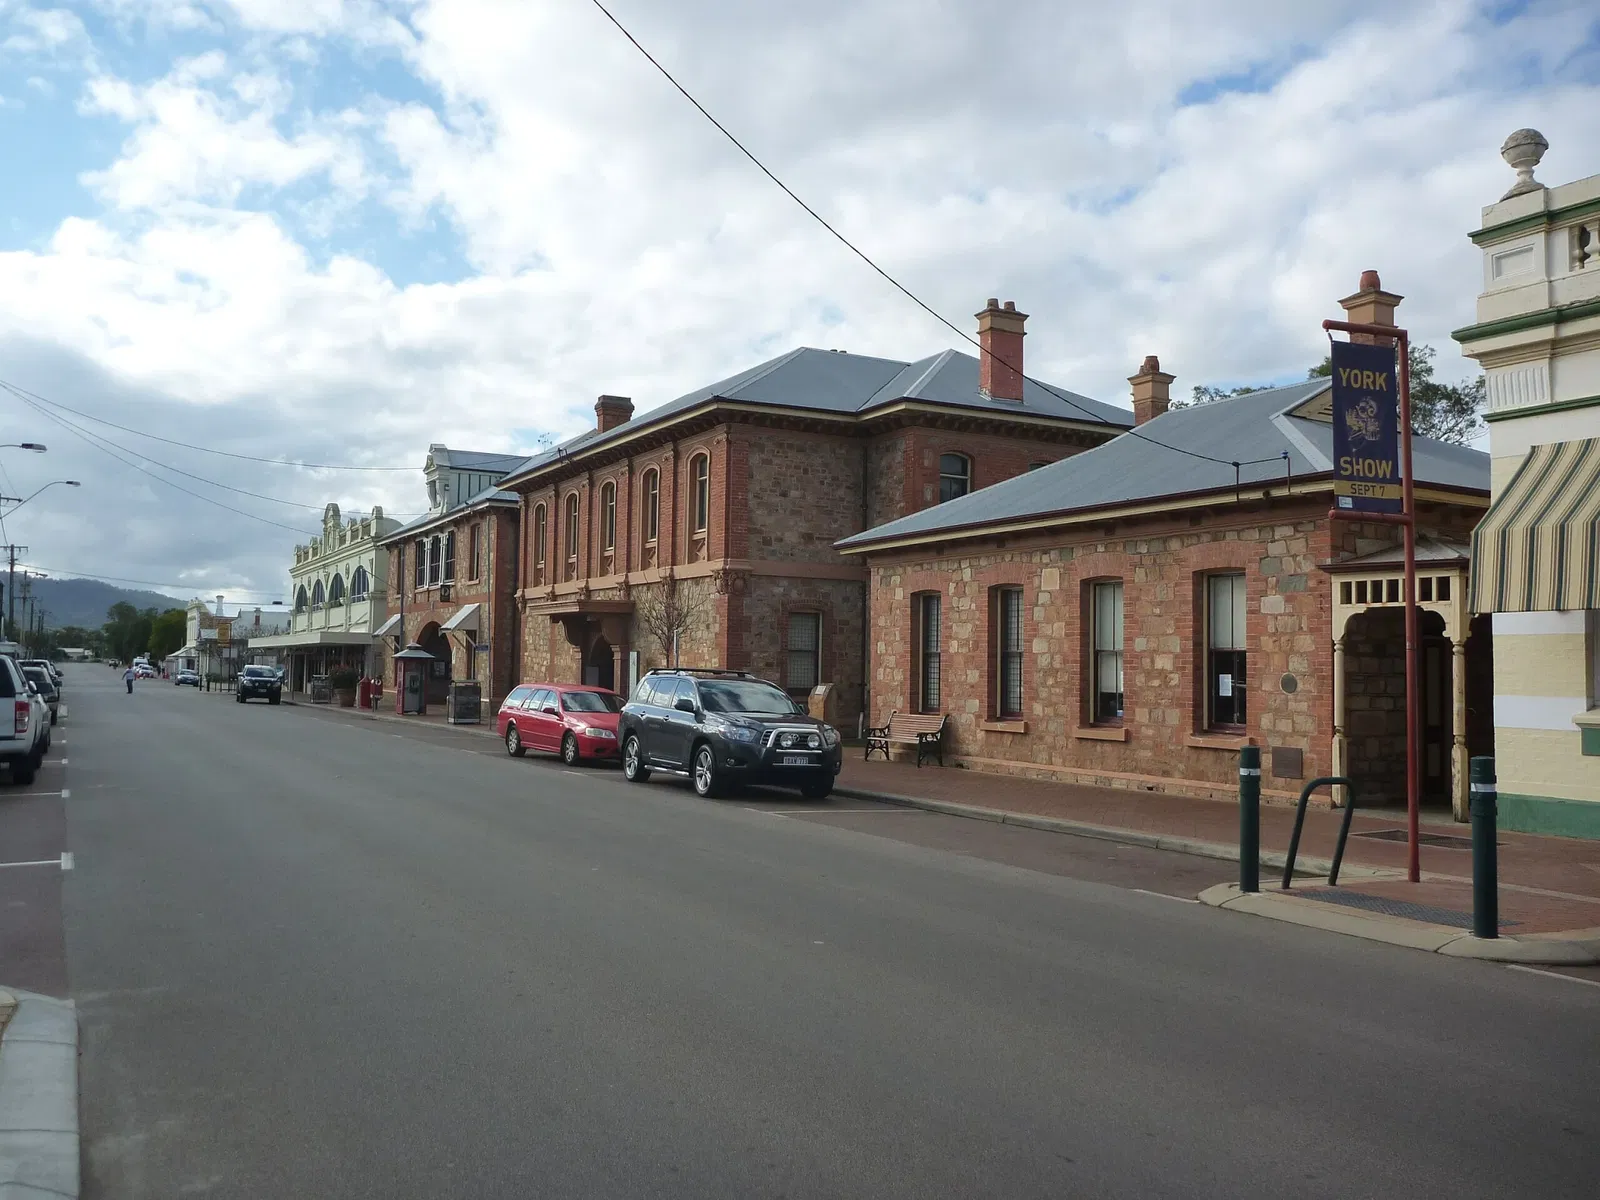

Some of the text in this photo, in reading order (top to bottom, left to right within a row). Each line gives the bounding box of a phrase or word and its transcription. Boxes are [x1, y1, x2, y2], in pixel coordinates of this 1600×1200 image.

[1339, 367, 1388, 392] YORK
[1340, 456, 1392, 479] SHOW
[1350, 483, 1386, 497] SEPT 7
